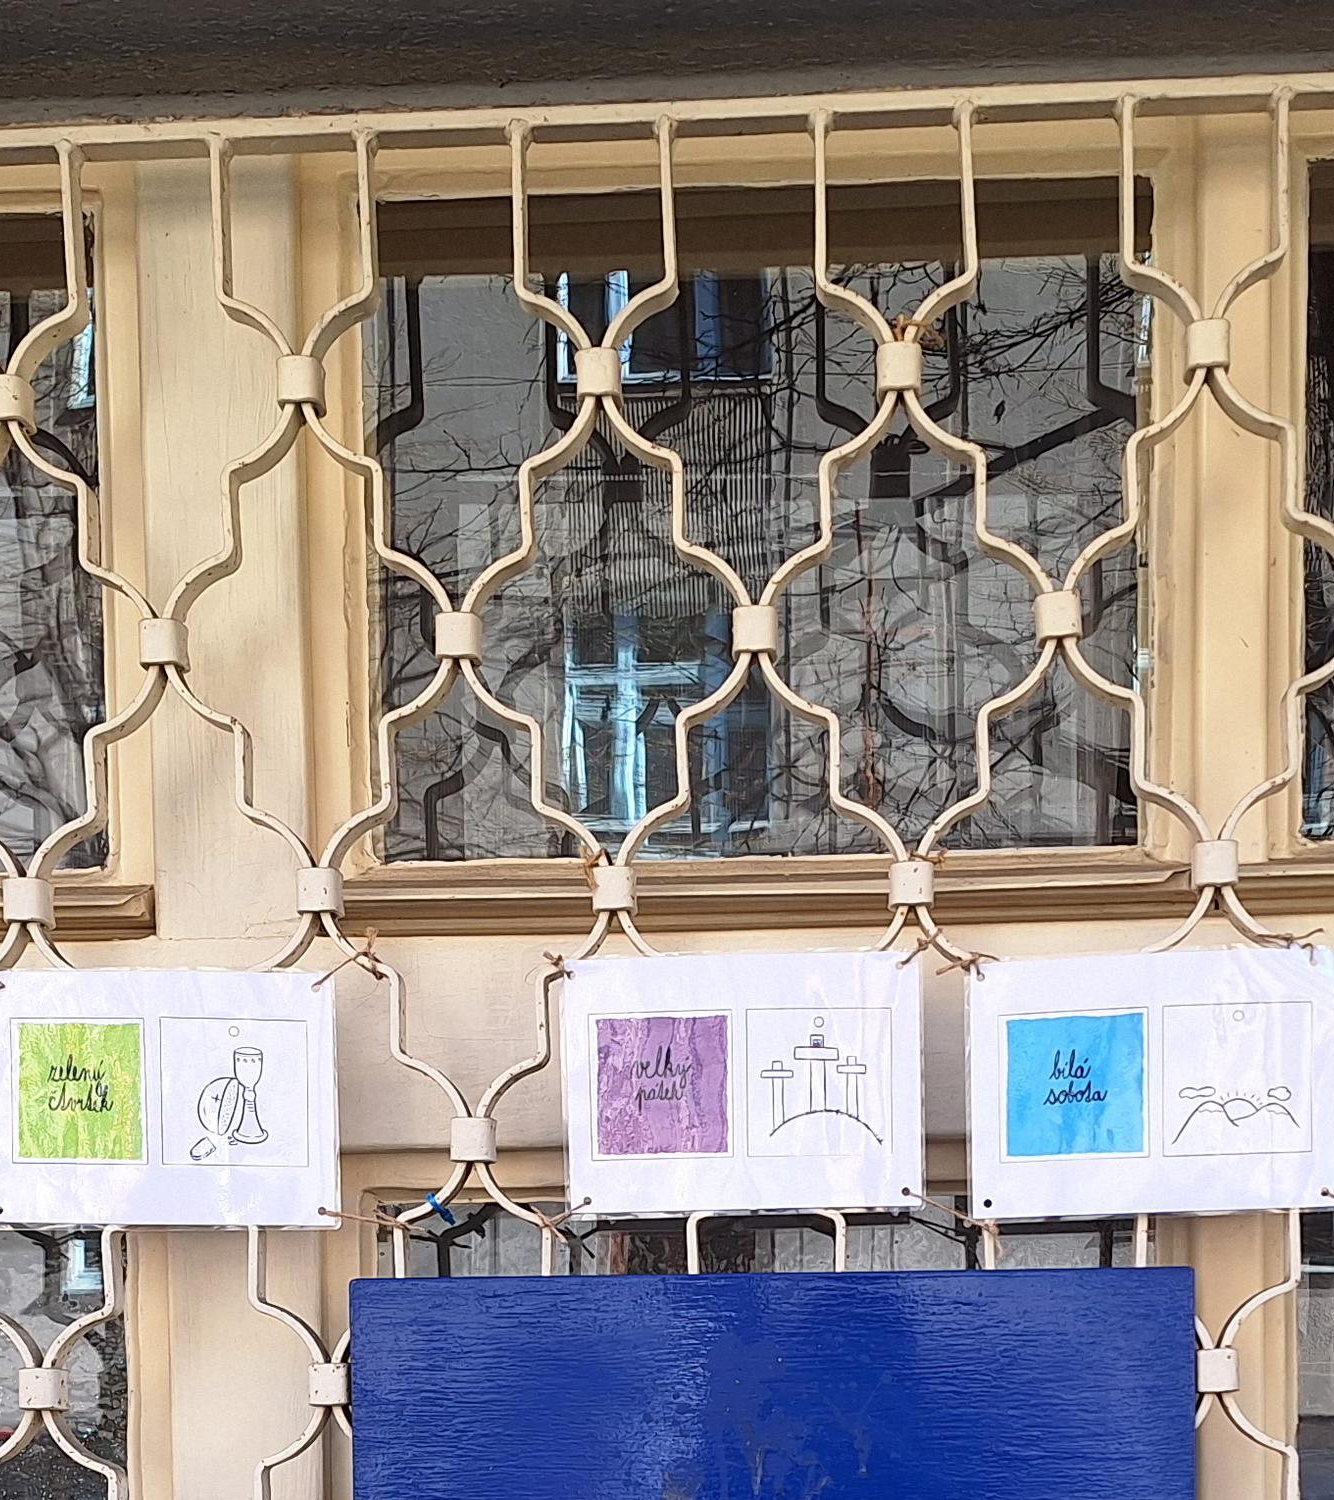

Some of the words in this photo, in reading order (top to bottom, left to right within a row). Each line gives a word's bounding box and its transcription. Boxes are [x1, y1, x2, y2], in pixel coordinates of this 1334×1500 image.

[630, 1045, 693, 1088] velký
[634, 1080, 683, 1112] pátek
[1043, 1080, 1108, 1105] sobota
